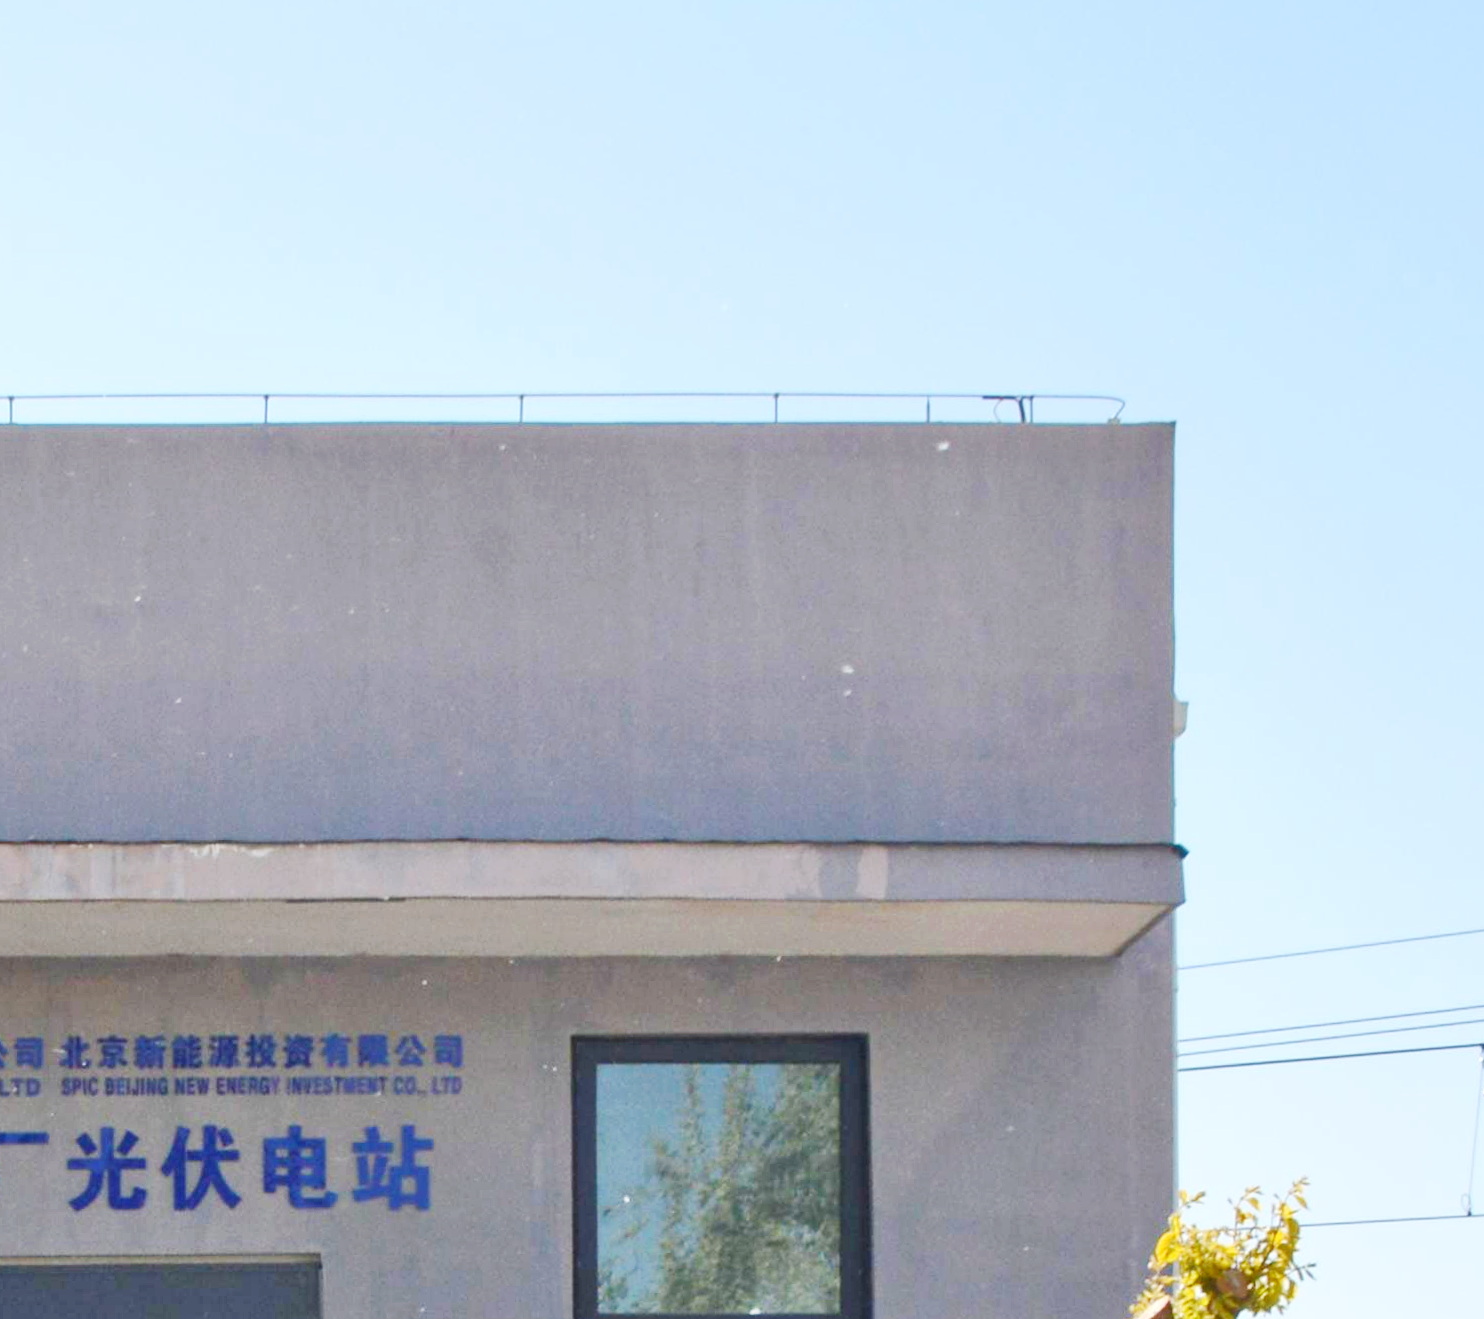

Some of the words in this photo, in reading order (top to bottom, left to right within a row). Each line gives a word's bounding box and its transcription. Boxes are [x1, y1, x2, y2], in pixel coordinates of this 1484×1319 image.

[59, 1034, 465, 1070] 北京新能源投资有限公司
[61, 1077, 99, 1097] SPIC
[105, 1077, 169, 1097] BEIJING
[174, 1077, 210, 1096] NEW
[216, 1076, 281, 1096] ENERGY
[287, 1076, 387, 1096] INVESTMENT
